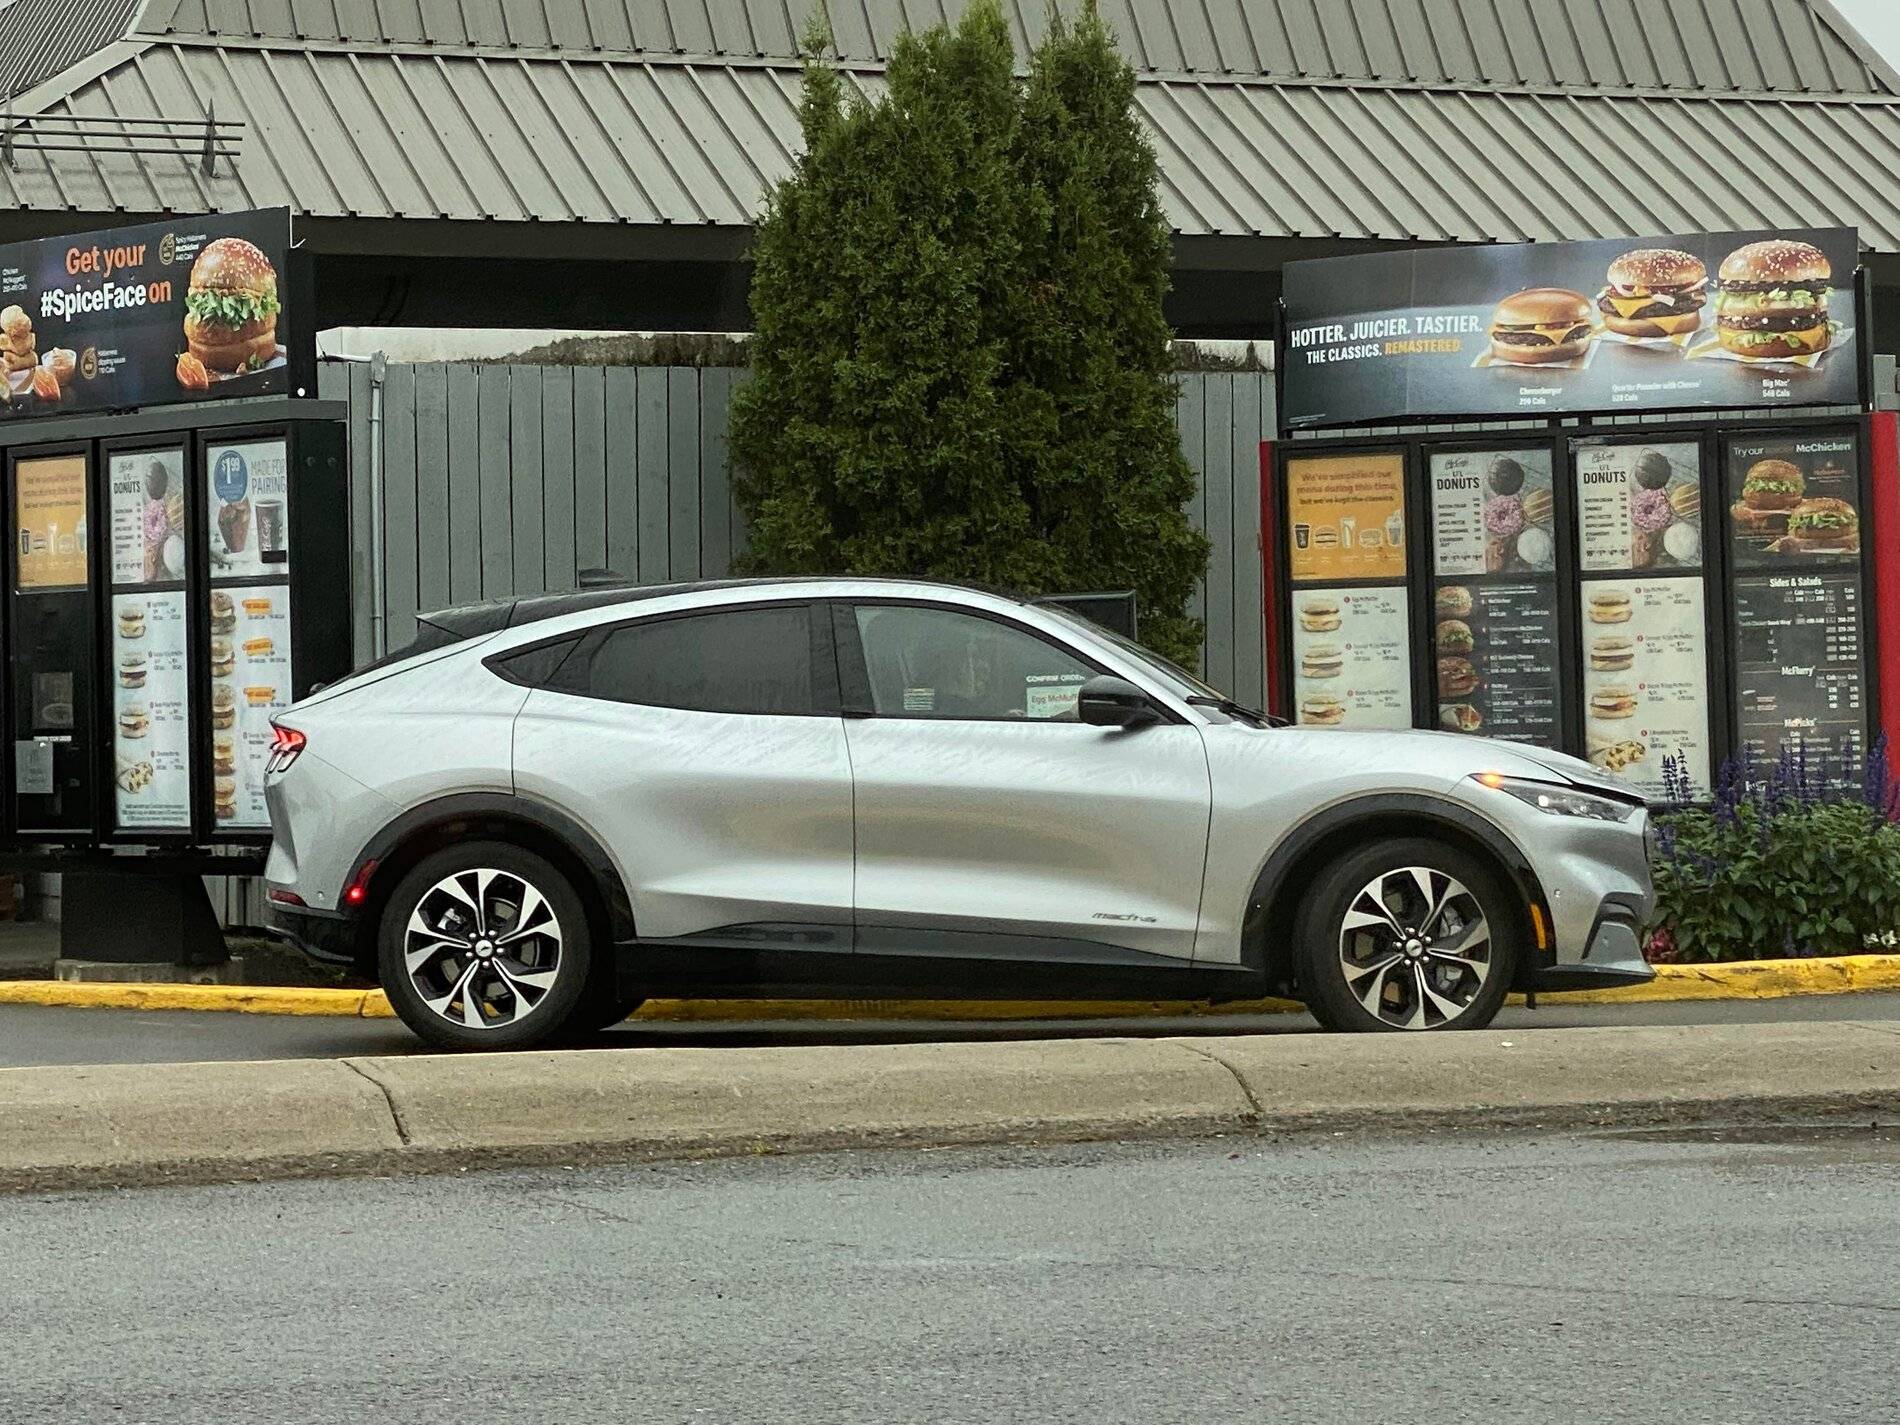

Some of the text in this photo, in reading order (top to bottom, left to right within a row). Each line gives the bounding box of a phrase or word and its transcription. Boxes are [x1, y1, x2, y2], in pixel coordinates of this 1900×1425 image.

[66, 244, 146, 277] Get your
[40, 281, 172, 322] #SpiceFace on
[1291, 315, 1483, 348] HOTTER. JUICIER. TASTIER.
[1306, 350, 1326, 364] THE
[1328, 343, 1383, 362] CLASSICS.
[1762, 379, 1774, 388] Big
[1733, 446, 1747, 458] Try
[1748, 446, 1764, 456] our
[1796, 442, 1851, 453] McChicken
[1437, 477, 1480, 490] DONUTS
[1583, 471, 1626, 484] DONUTS
[114, 480, 141, 495] DONUTS
[1769, 577, 1822, 587] Sides & Salads
[1781, 666, 1813, 676] McFlurry
[1031, 693, 1078, 705] Egg McMuff
